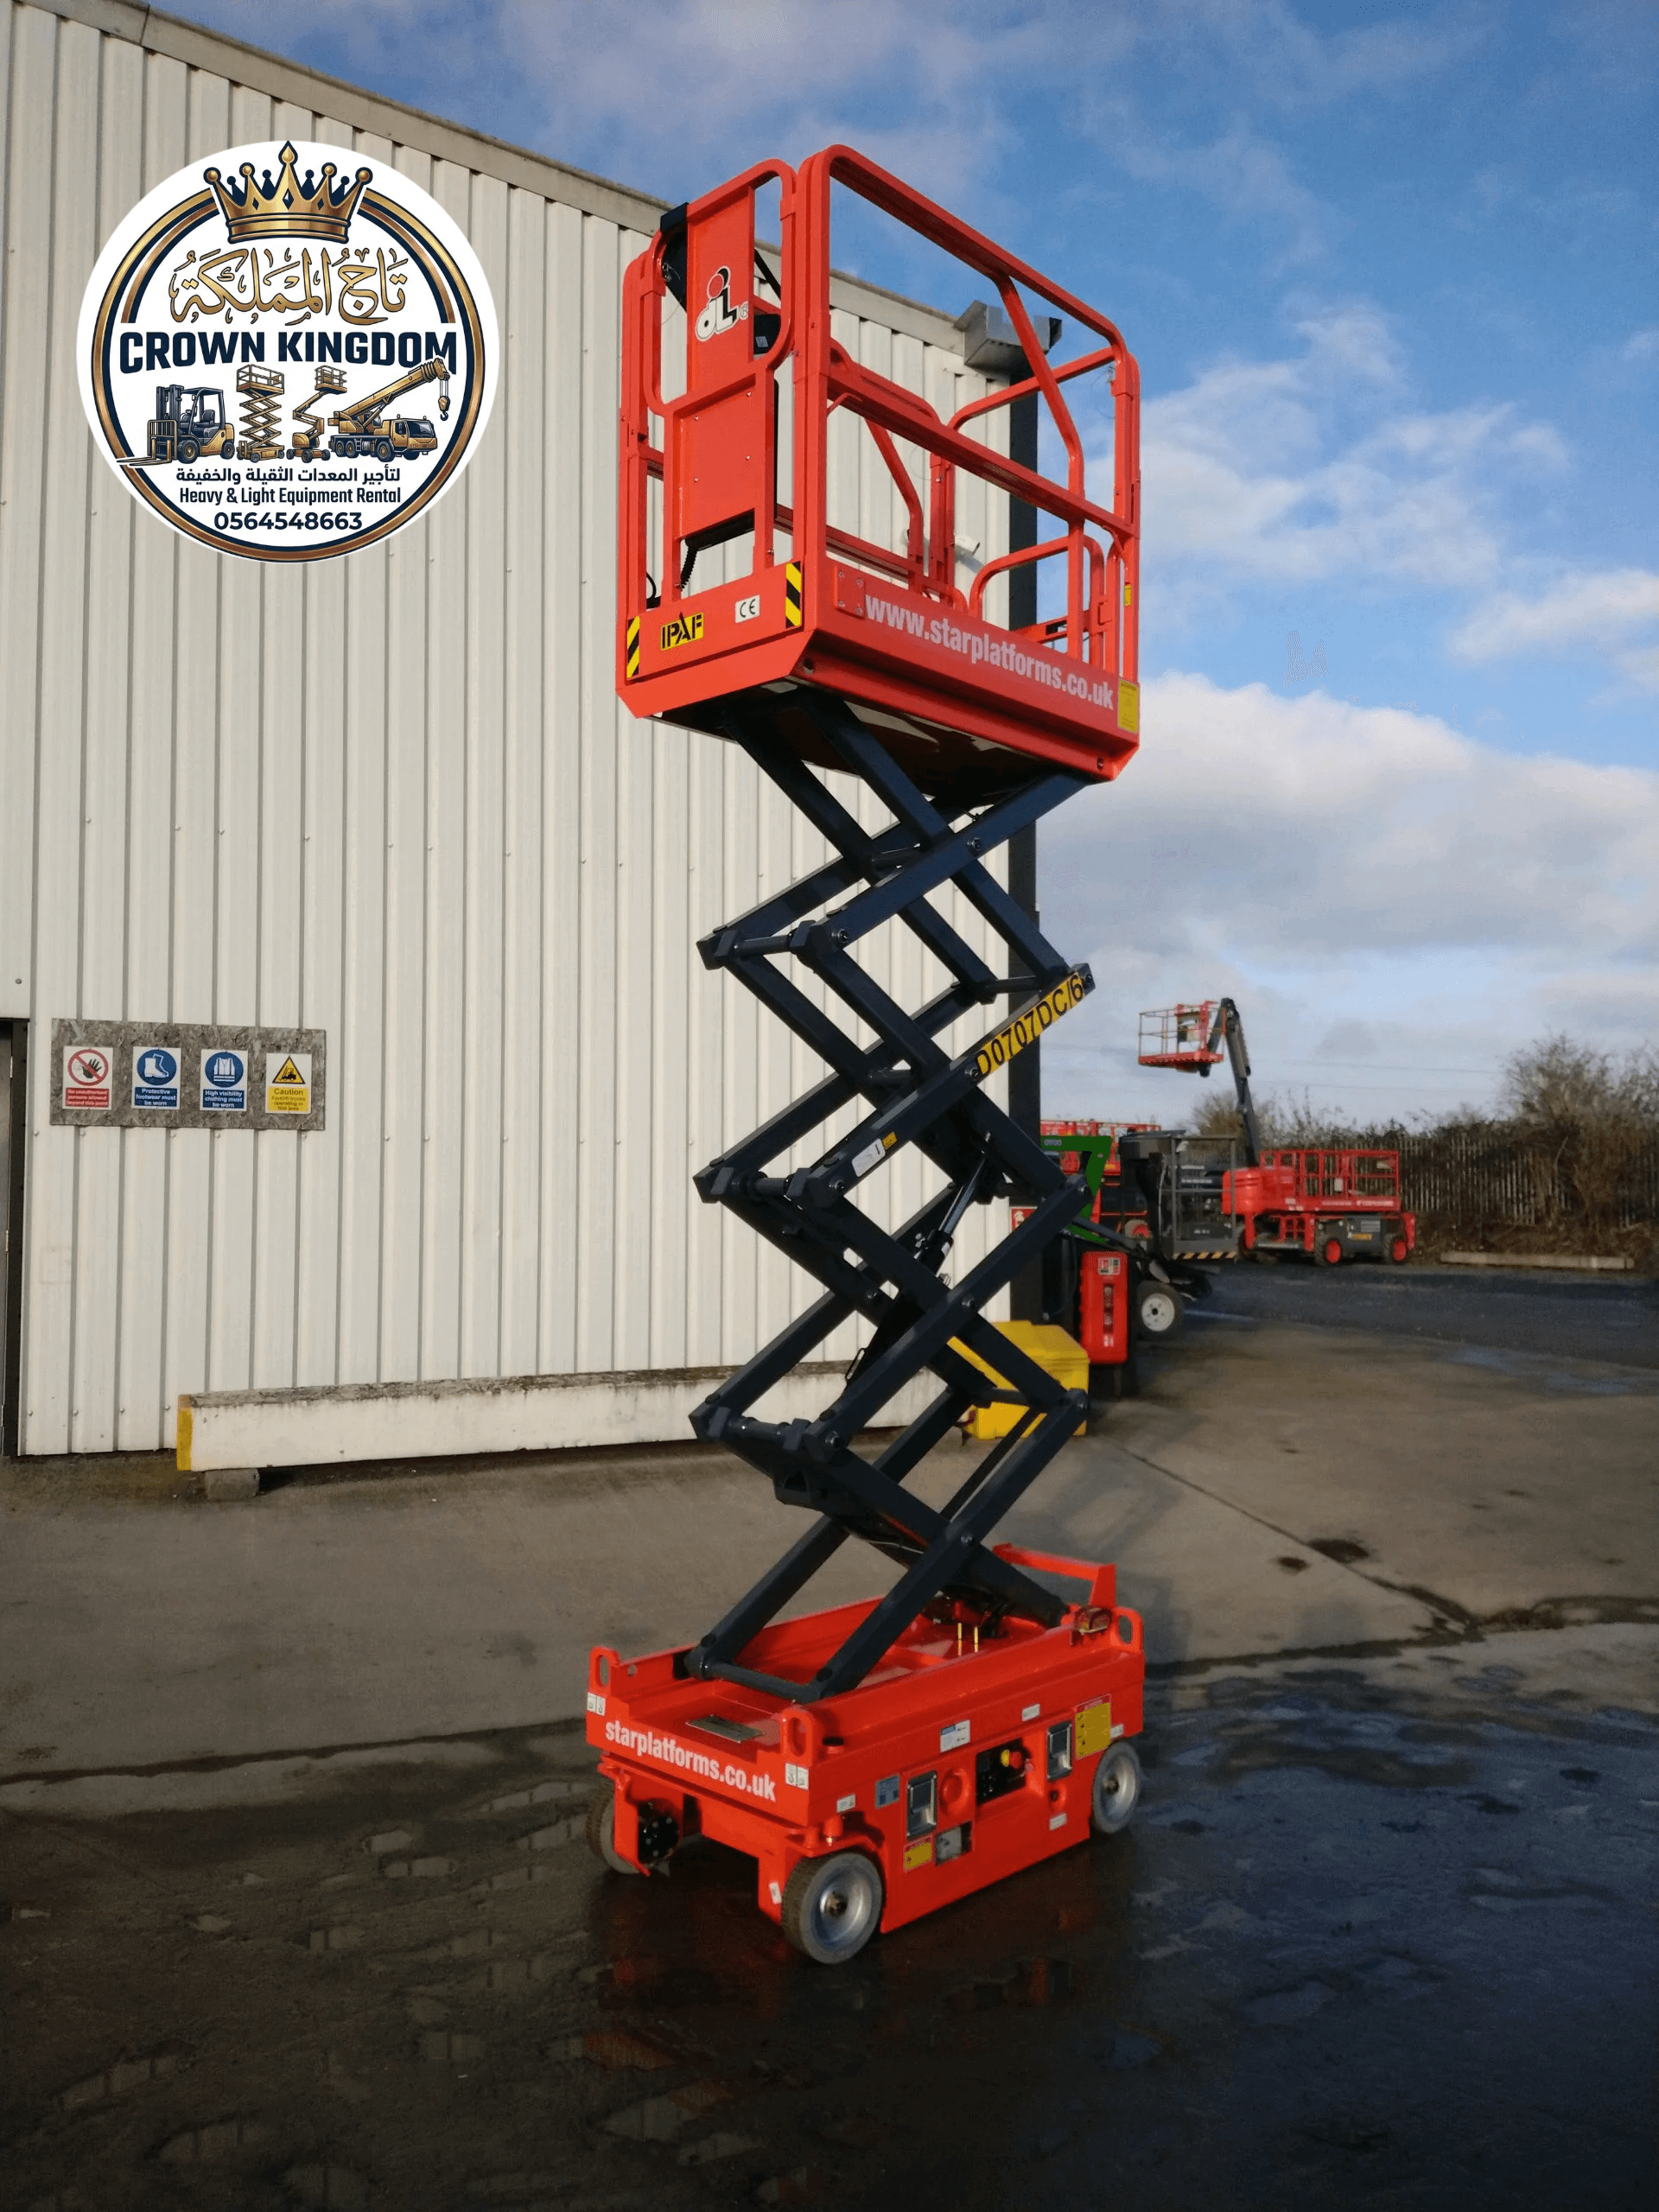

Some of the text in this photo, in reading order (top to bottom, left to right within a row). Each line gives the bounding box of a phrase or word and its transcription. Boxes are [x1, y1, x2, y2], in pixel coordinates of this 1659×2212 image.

[662, 612, 702, 648] IPAF
[740, 599, 756, 618] CE
[865, 594, 1114, 710] www.starplatforms.co.uk
[975, 974, 1084, 1077] D0707DC/6
[605, 1719, 776, 1802] starplatforms.co.uk
